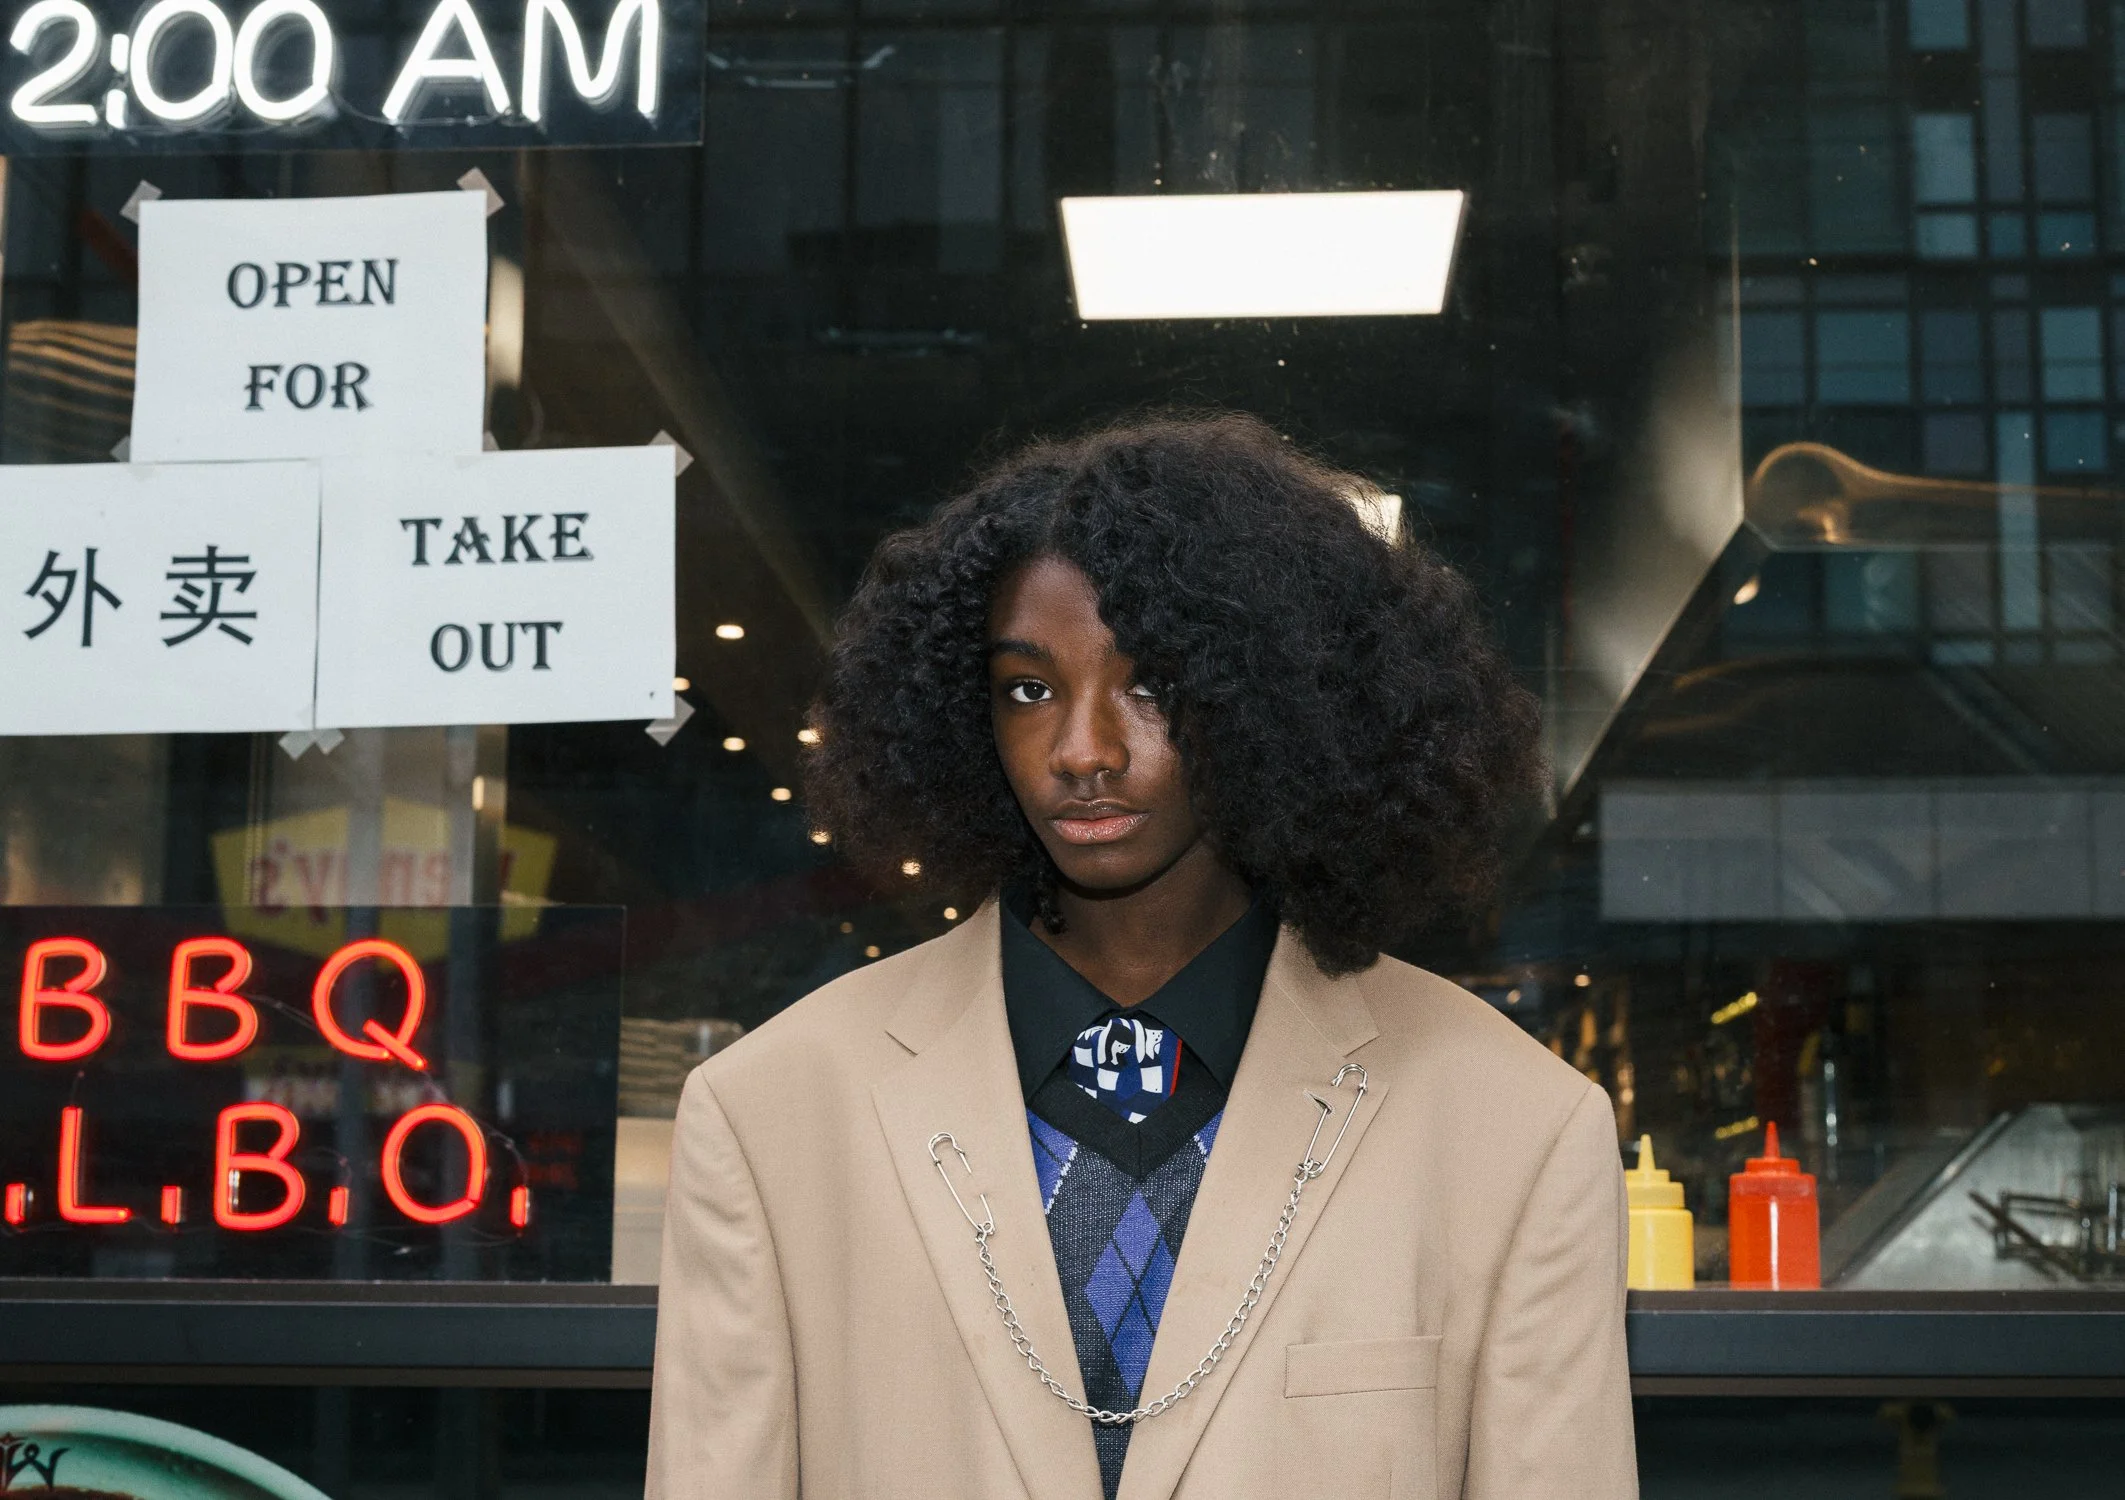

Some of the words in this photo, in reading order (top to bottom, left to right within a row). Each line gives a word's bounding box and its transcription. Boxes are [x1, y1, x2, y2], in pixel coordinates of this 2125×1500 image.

[11, 0, 332, 129] 2:00
[382, 0, 661, 123] AM
[227, 258, 399, 309] OPEN
[244, 361, 372, 412] FOR
[400, 512, 594, 566] TAKE
[23, 544, 258, 648] 外卖
[430, 621, 563, 672] OUT
